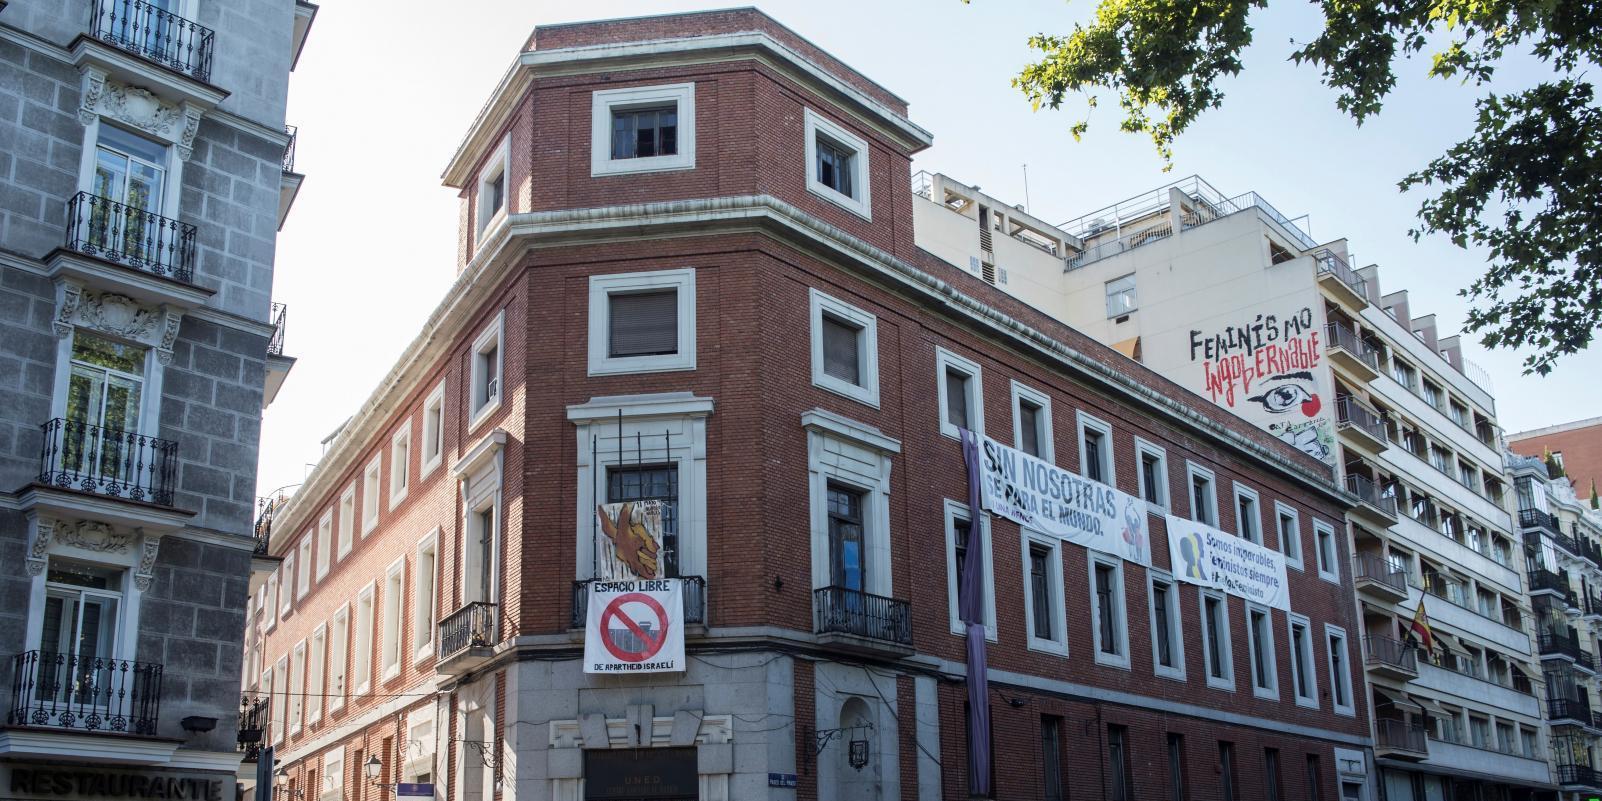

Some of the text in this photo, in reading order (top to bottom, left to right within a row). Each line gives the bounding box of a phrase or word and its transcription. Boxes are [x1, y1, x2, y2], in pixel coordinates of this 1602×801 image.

[984, 440, 1116, 519] SIN NOSOTRAS
[986, 474, 1002, 499] SE
[1005, 484, 1038, 515] PARA
[1041, 498, 1056, 522] EL
[1206, 533, 1276, 573] Somos imparables,
[1210, 552, 1248, 577] eministas
[594, 582, 635, 592] ESPACIO
[594, 663, 604, 671] DE
[605, 663, 642, 671] APARTHEID
[10, 768, 223, 801] RESTAURANTE
